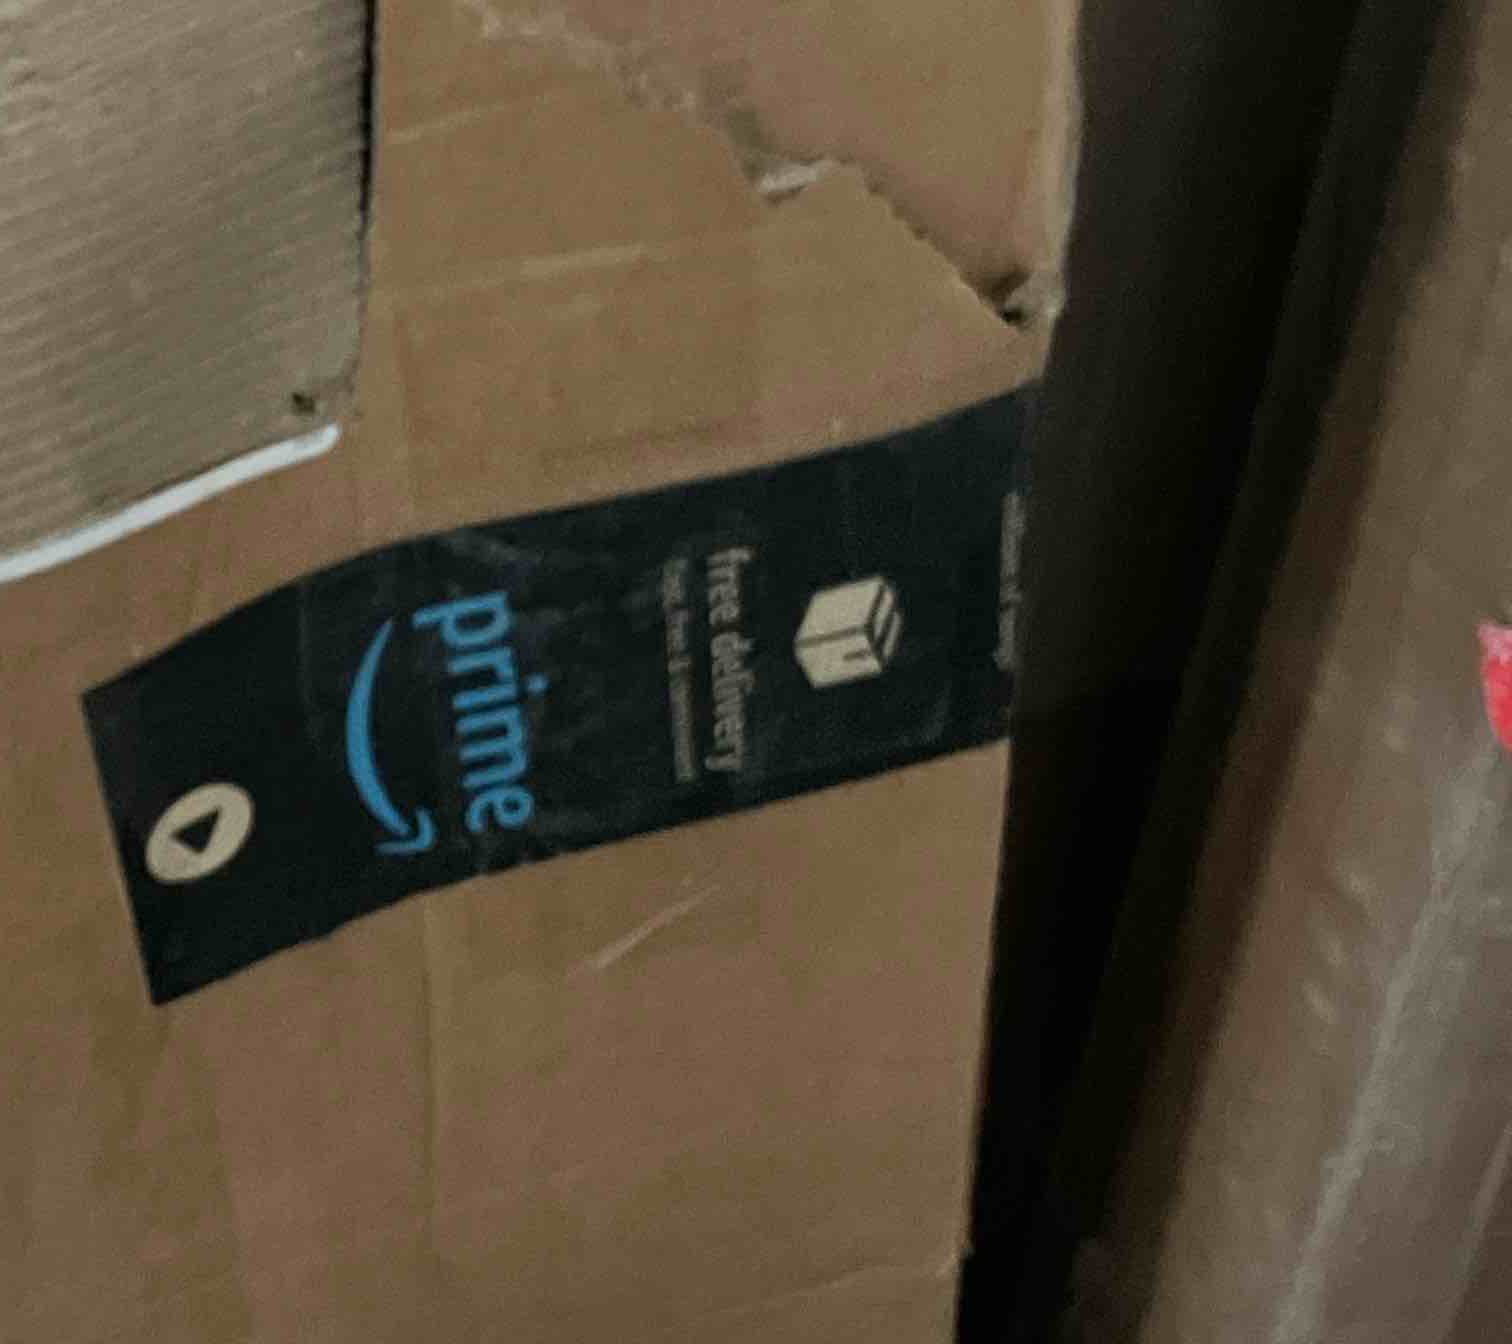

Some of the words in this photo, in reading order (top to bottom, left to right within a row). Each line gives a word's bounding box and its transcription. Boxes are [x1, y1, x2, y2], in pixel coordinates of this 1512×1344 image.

[705, 546, 753, 630] free
[412, 591, 550, 834] prime
[703, 632, 755, 772] delivery
